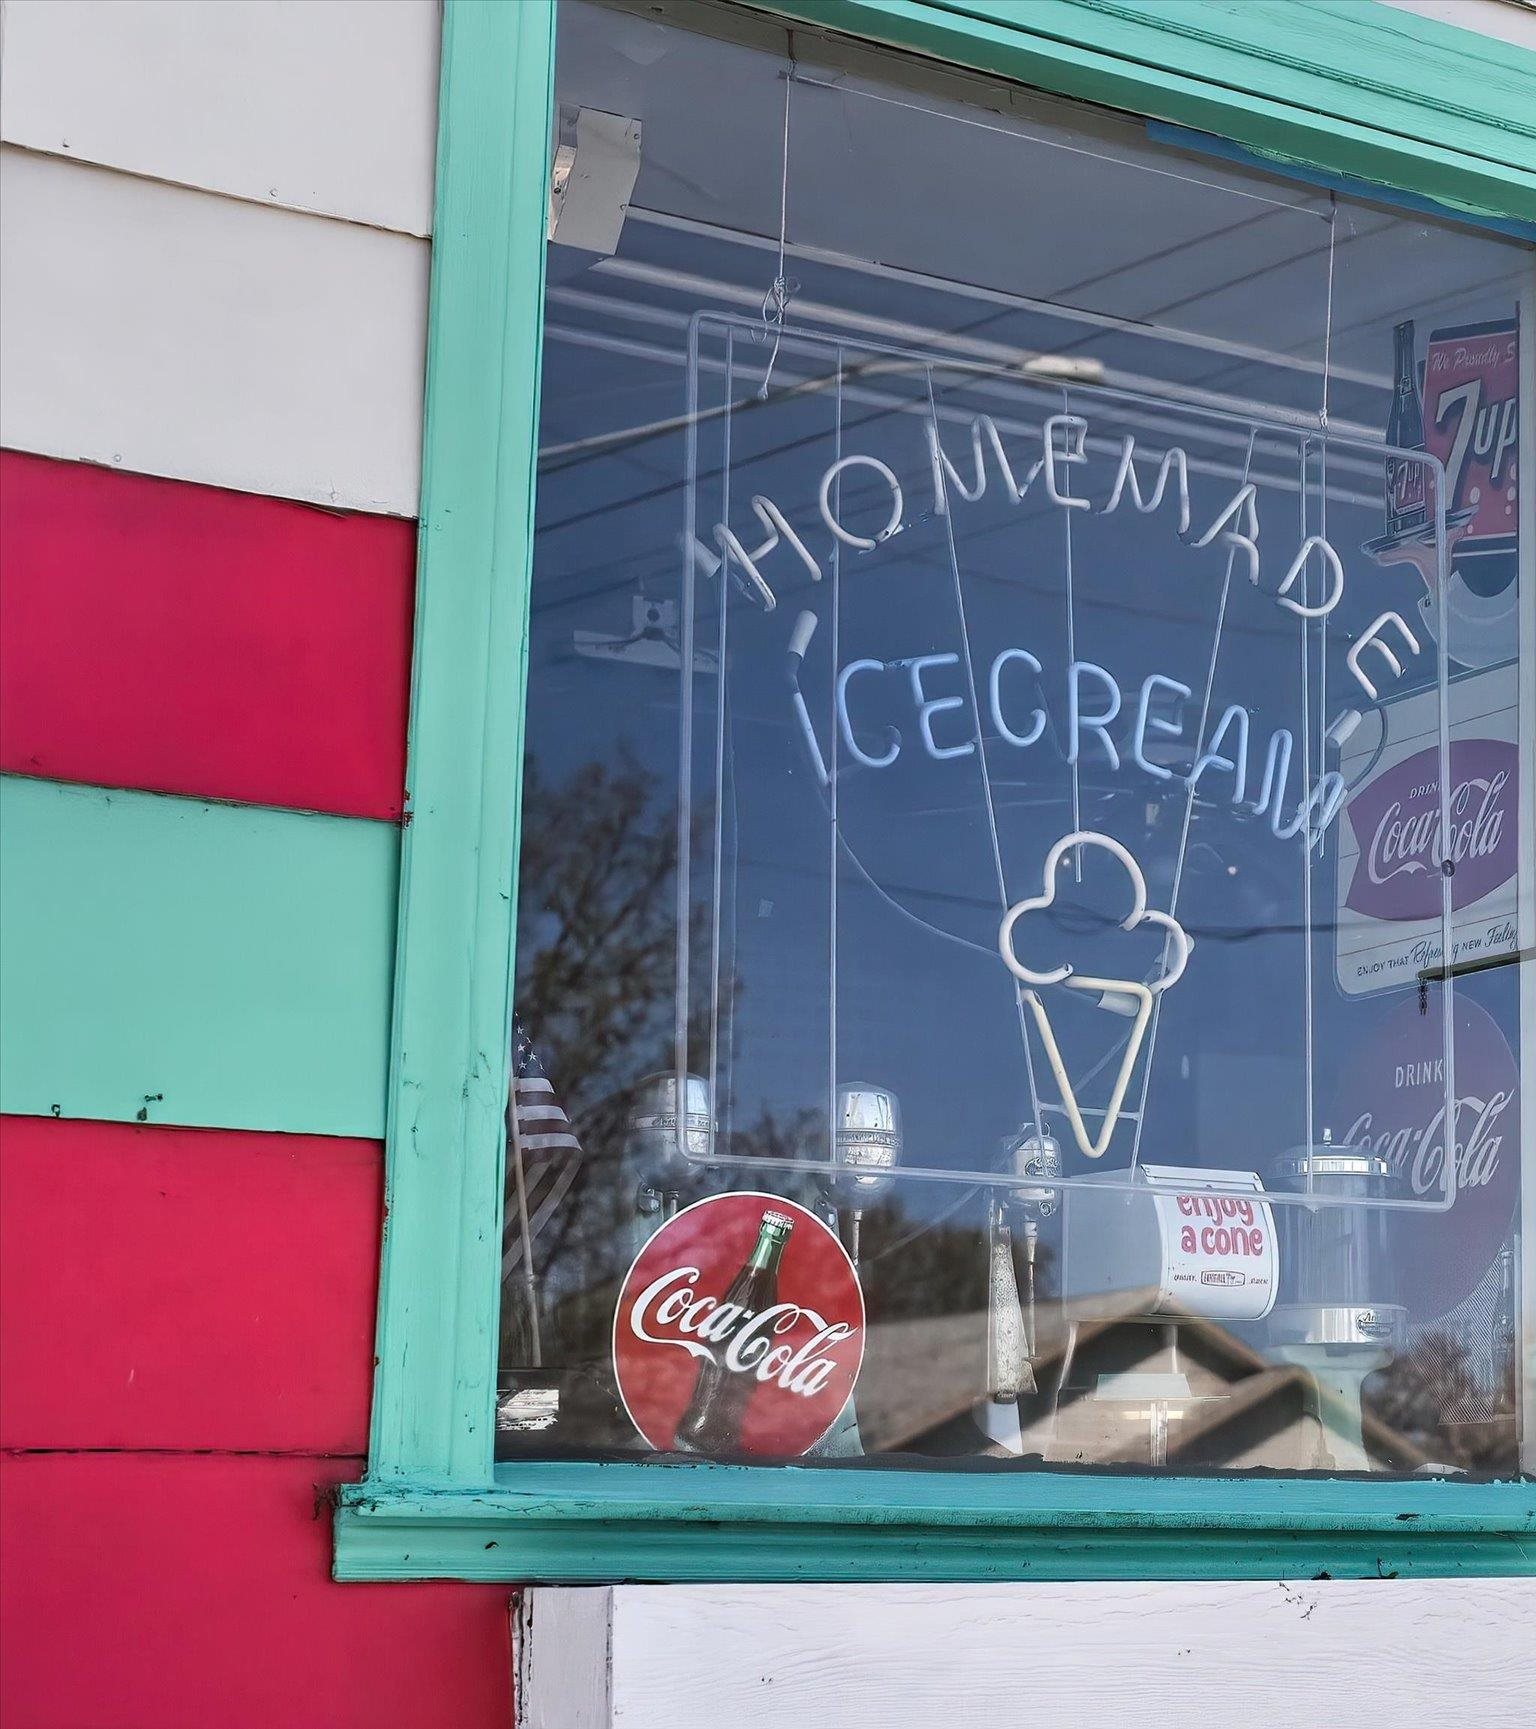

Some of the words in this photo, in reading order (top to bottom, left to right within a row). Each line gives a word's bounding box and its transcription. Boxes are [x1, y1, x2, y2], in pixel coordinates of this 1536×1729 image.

[712, 414, 1421, 700] HOMEMADE
[1408, 780, 1441, 799] DRIN
[1461, 939, 1481, 951] NEW
[1395, 1059, 1444, 1088] DRINK
[1181, 1225, 1197, 1254] a
[1200, 1226, 1263, 1256] cone
[630, 1266, 857, 1398] Coca-Cola
